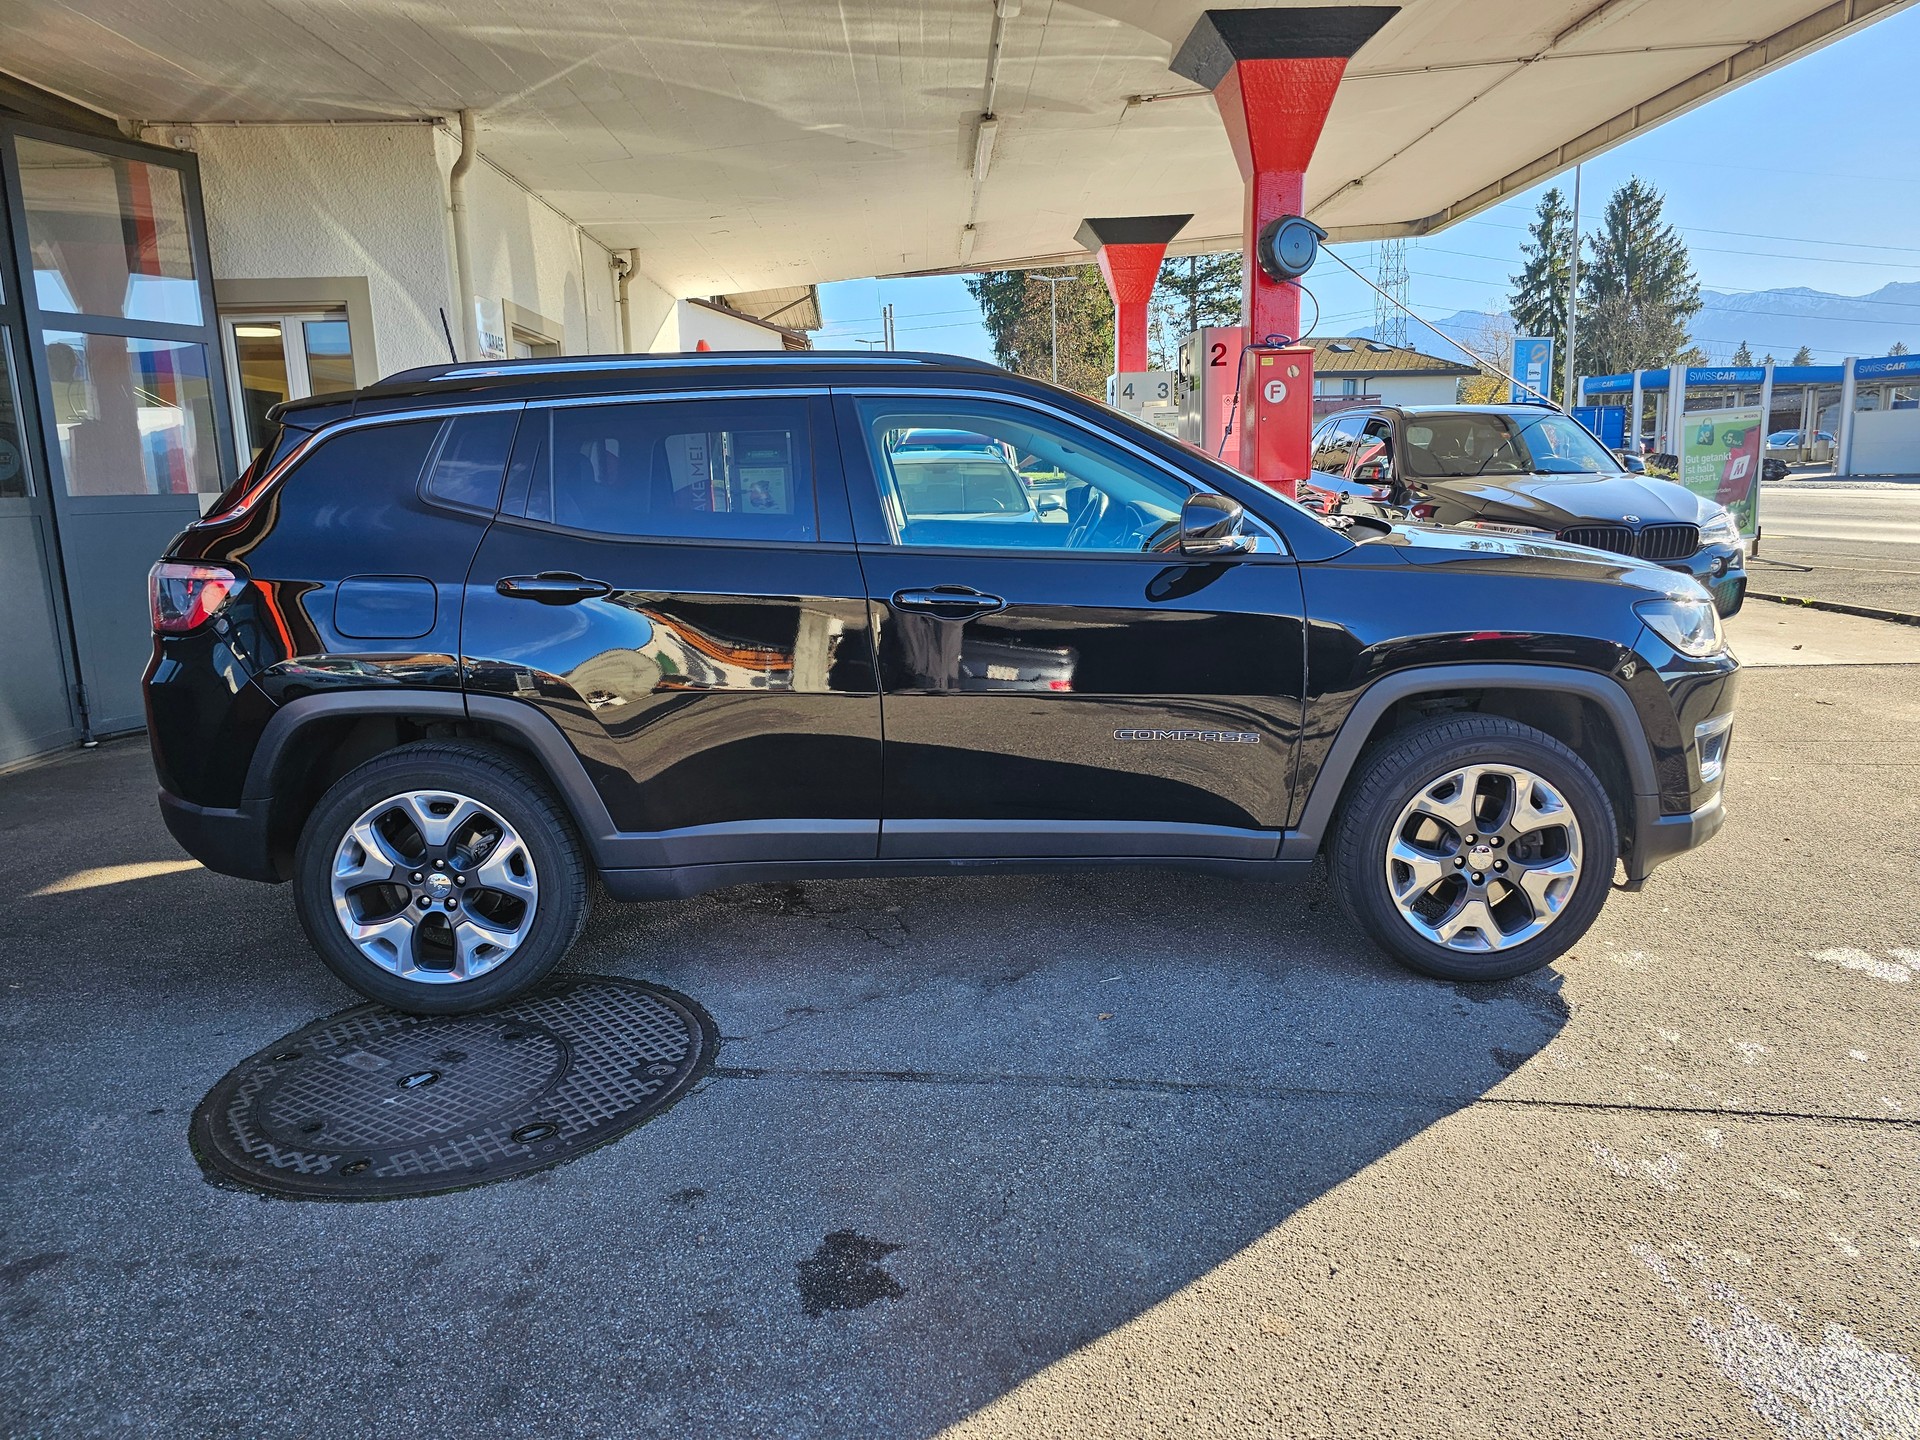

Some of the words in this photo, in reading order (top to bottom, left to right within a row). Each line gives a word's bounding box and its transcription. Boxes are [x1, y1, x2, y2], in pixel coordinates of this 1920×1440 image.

[1210, 342, 1227, 367] 2
[1122, 382, 1135, 400] 4
[1157, 382, 1169, 399] 3
[1269, 384, 1282, 399] F
[689, 446, 705, 477] ME!
[1685, 455, 1700, 464] Gut
[1701, 452, 1733, 464] getankt
[1685, 465, 1696, 474] ist
[1697, 463, 1715, 474] halb
[1685, 473, 1719, 485] gespart.
[691, 479, 706, 512] AKE
[1113, 729, 1261, 744] COMPASS
